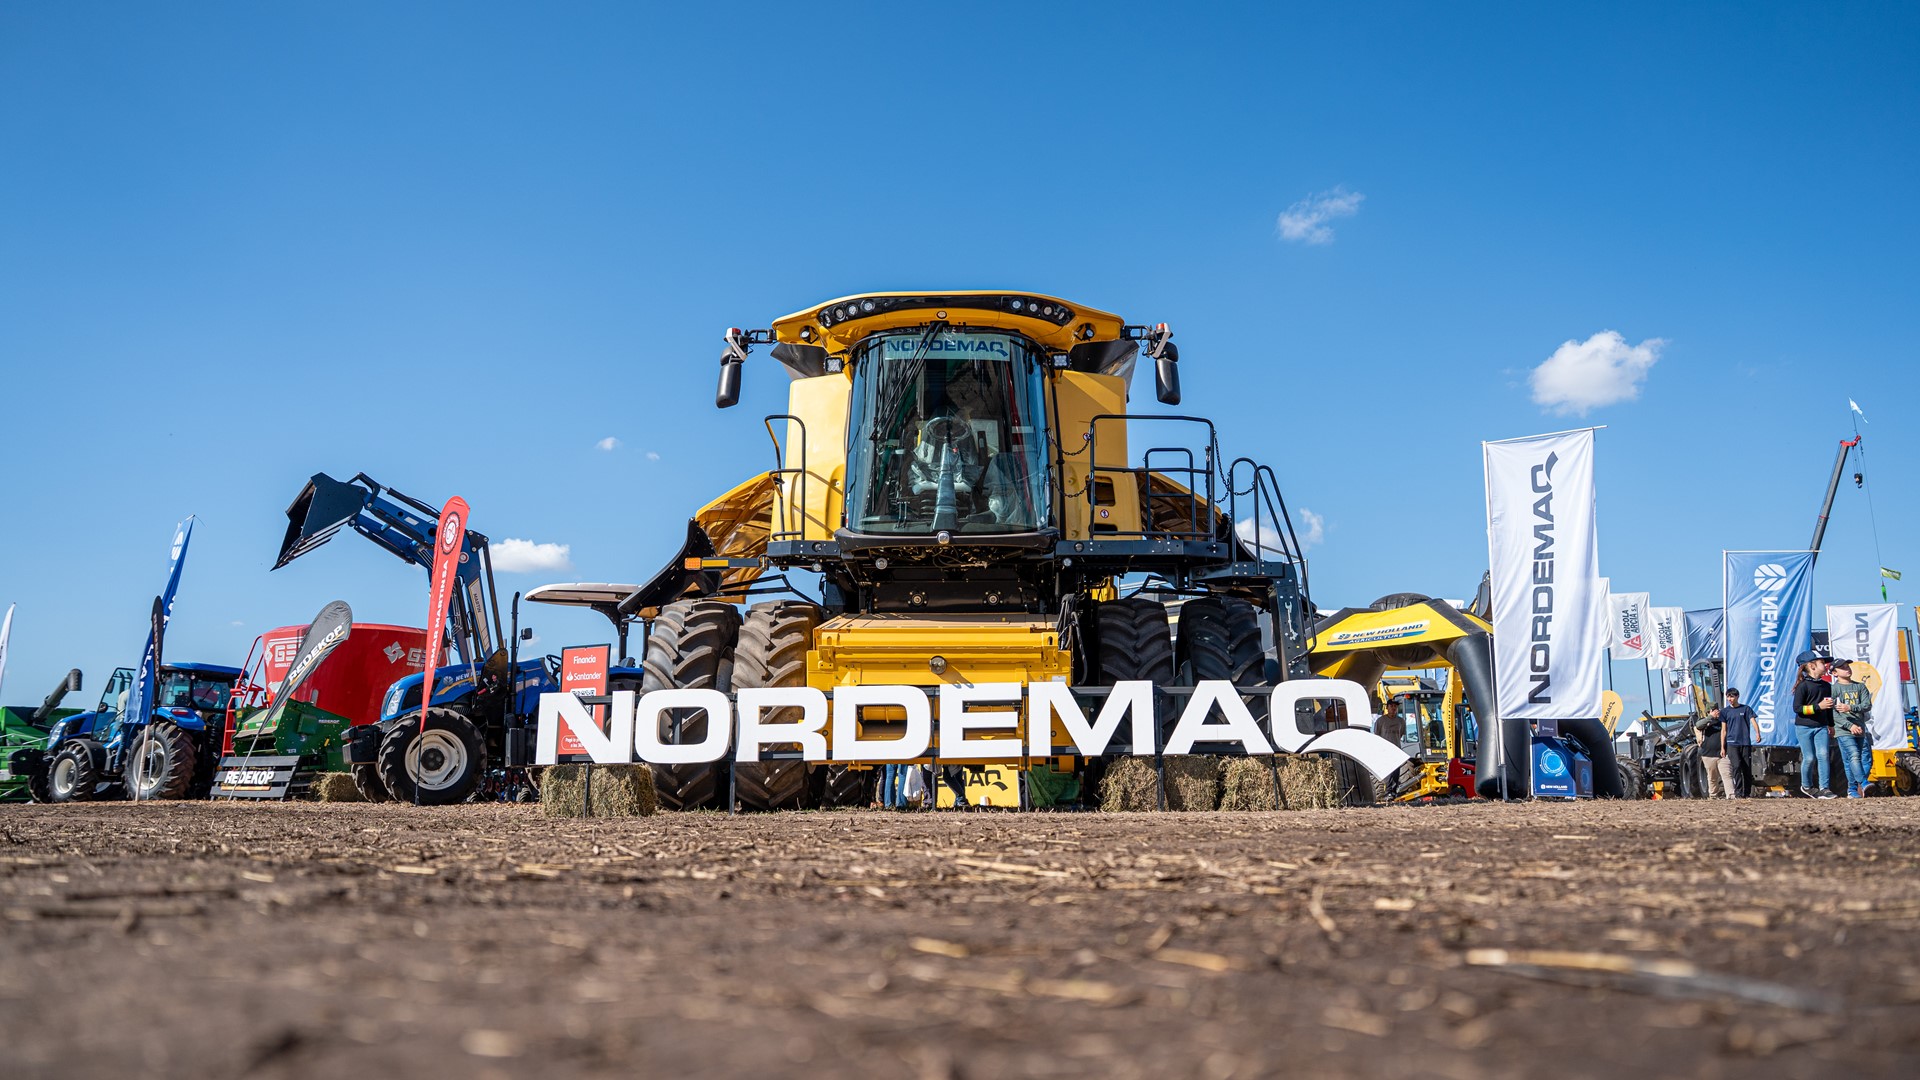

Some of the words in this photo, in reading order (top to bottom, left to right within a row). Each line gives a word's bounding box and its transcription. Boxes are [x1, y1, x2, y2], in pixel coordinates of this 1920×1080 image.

[1528, 451, 1559, 704] NORDEMAQ
[473, 593, 482, 613] MARTIN
[429, 630, 439, 668] OMAR
[435, 579, 446, 628] MARTIN
[1376, 623, 1424, 634] HOLLAND
[1348, 633, 1404, 644] AGRICULTURE
[288, 625, 342, 682] REDEKOP
[574, 655, 596, 664] Financia
[574, 672, 602, 680] Santander
[535, 679, 1410, 781] NORDEMAQ
[224, 770, 274, 784] REDEKOP
